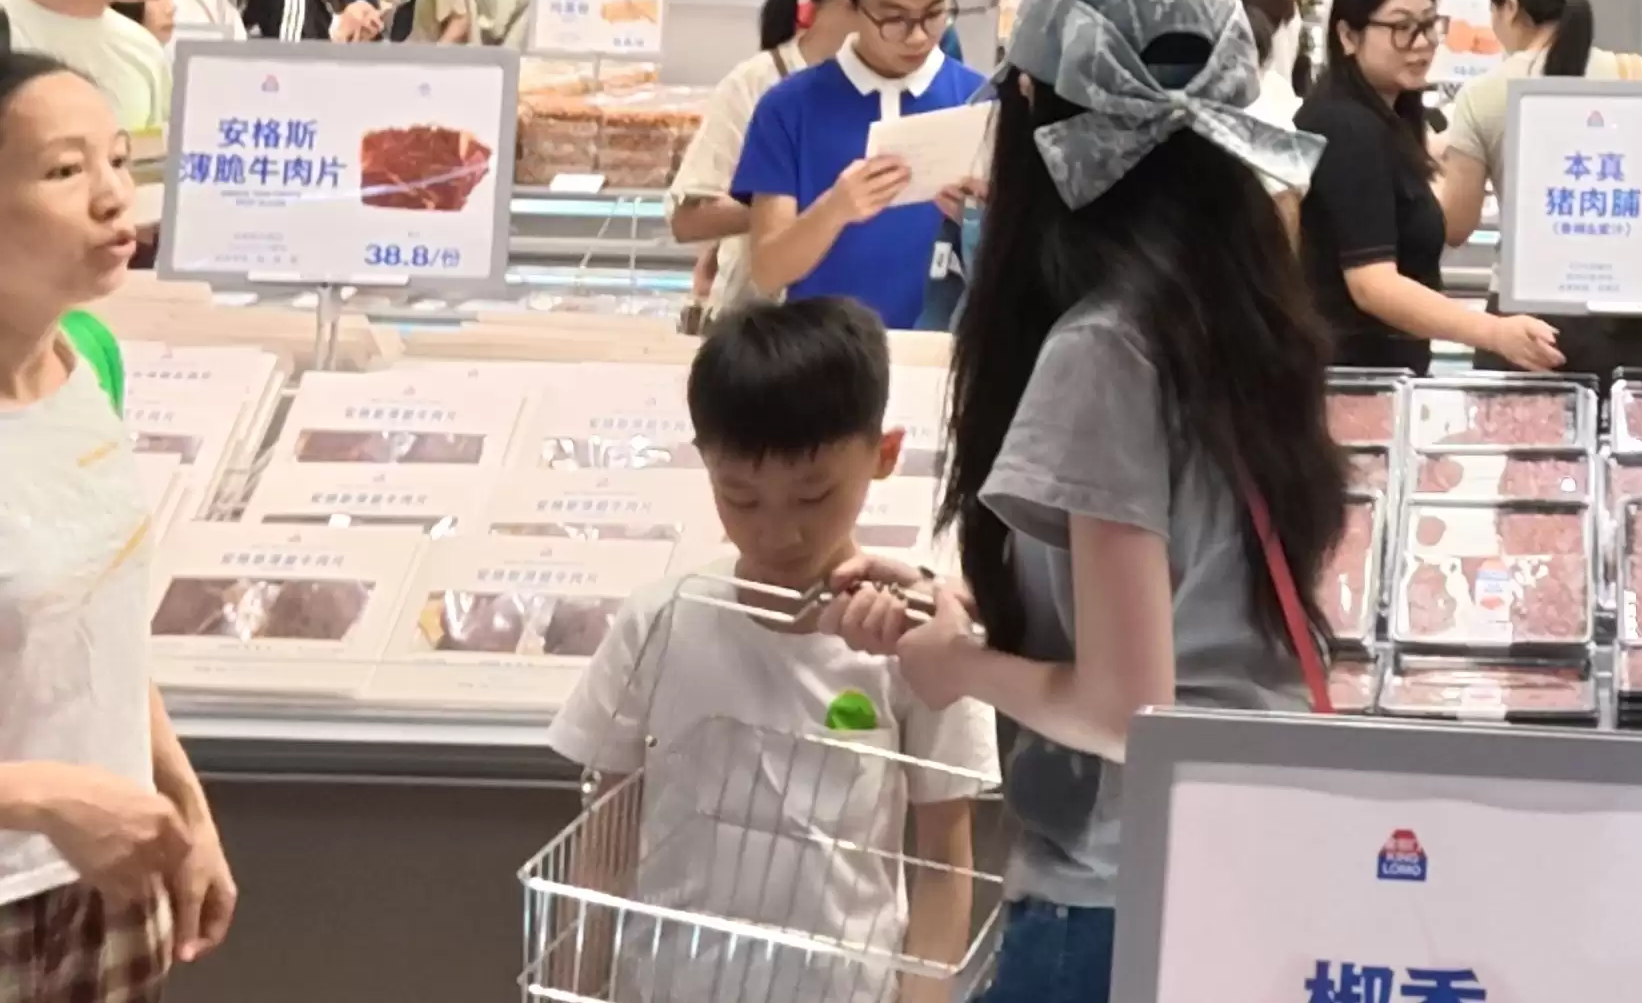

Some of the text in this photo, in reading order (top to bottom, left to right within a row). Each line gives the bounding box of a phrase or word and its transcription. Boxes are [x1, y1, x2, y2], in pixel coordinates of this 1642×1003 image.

[217, 117, 318, 149] 安格斯
[179, 151, 347, 188] 薄脆牛肉片
[1564, 151, 1625, 182] 本真
[1545, 187, 1642, 219] 猪肉脯
[364, 243, 461, 267] 38.8/份
